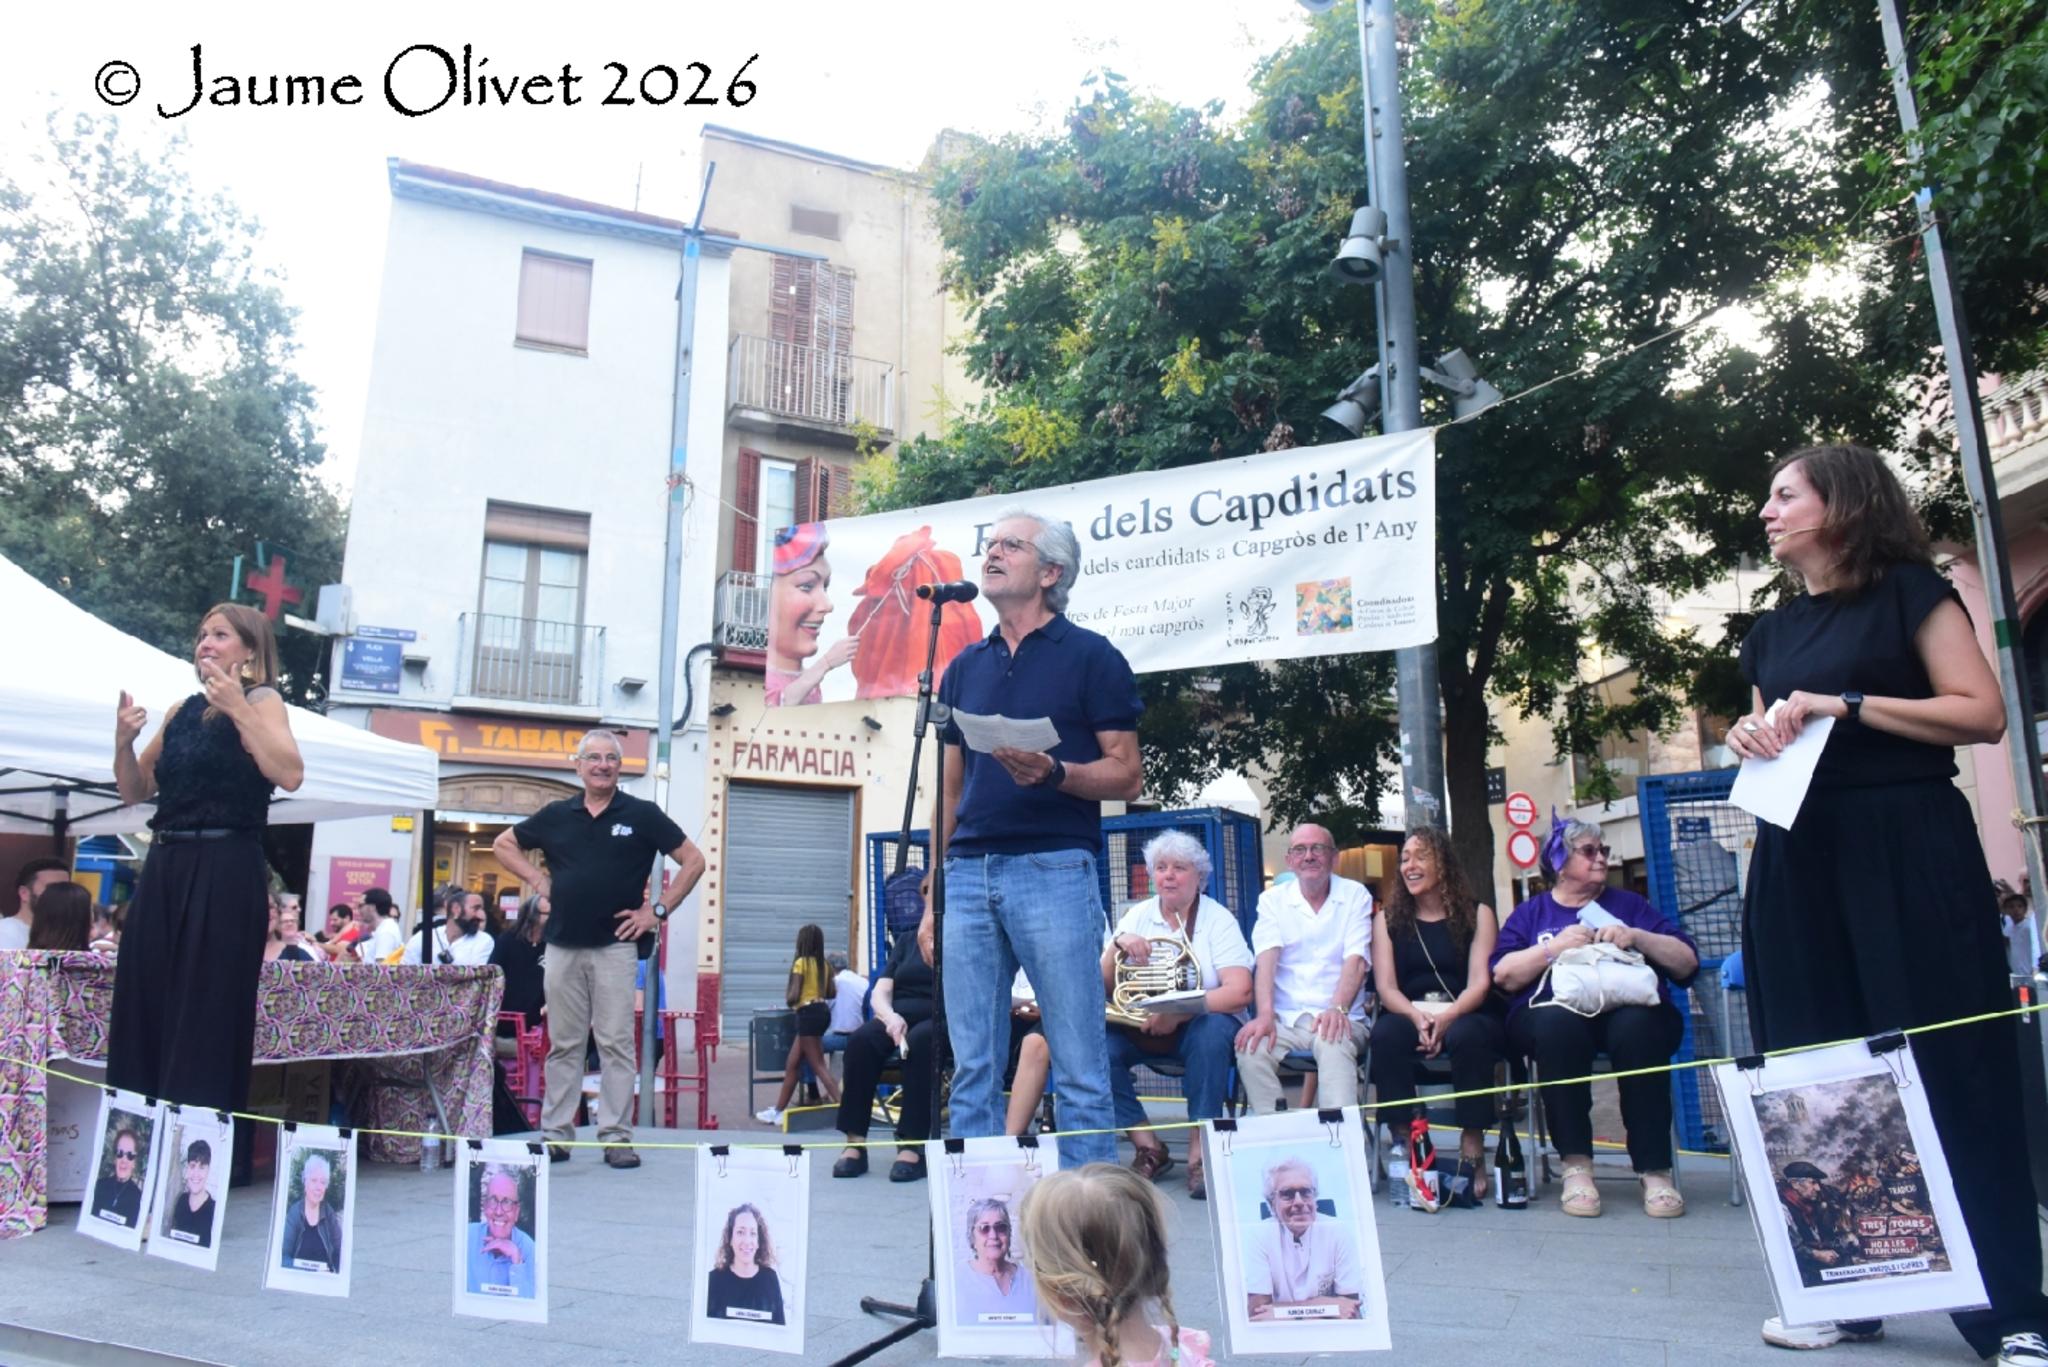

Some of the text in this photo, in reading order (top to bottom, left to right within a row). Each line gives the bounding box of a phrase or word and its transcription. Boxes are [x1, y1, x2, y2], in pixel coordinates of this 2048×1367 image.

[1090, 498, 1173, 542] dels
[1190, 467, 1417, 532] Capdidats
[1084, 556, 1120, 576] dels
[1126, 545, 1210, 570] candidats
[1216, 548, 1225, 559] a
[1232, 530, 1317, 558] Capgròs
[1323, 525, 1348, 545] de
[1113, 604, 1149, 618] Festa
[1152, 597, 1196, 613] Major
[1149, 615, 1205, 637] capgròs
[478, 724, 586, 753] TABAC
[733, 741, 856, 778] FARMACIA
